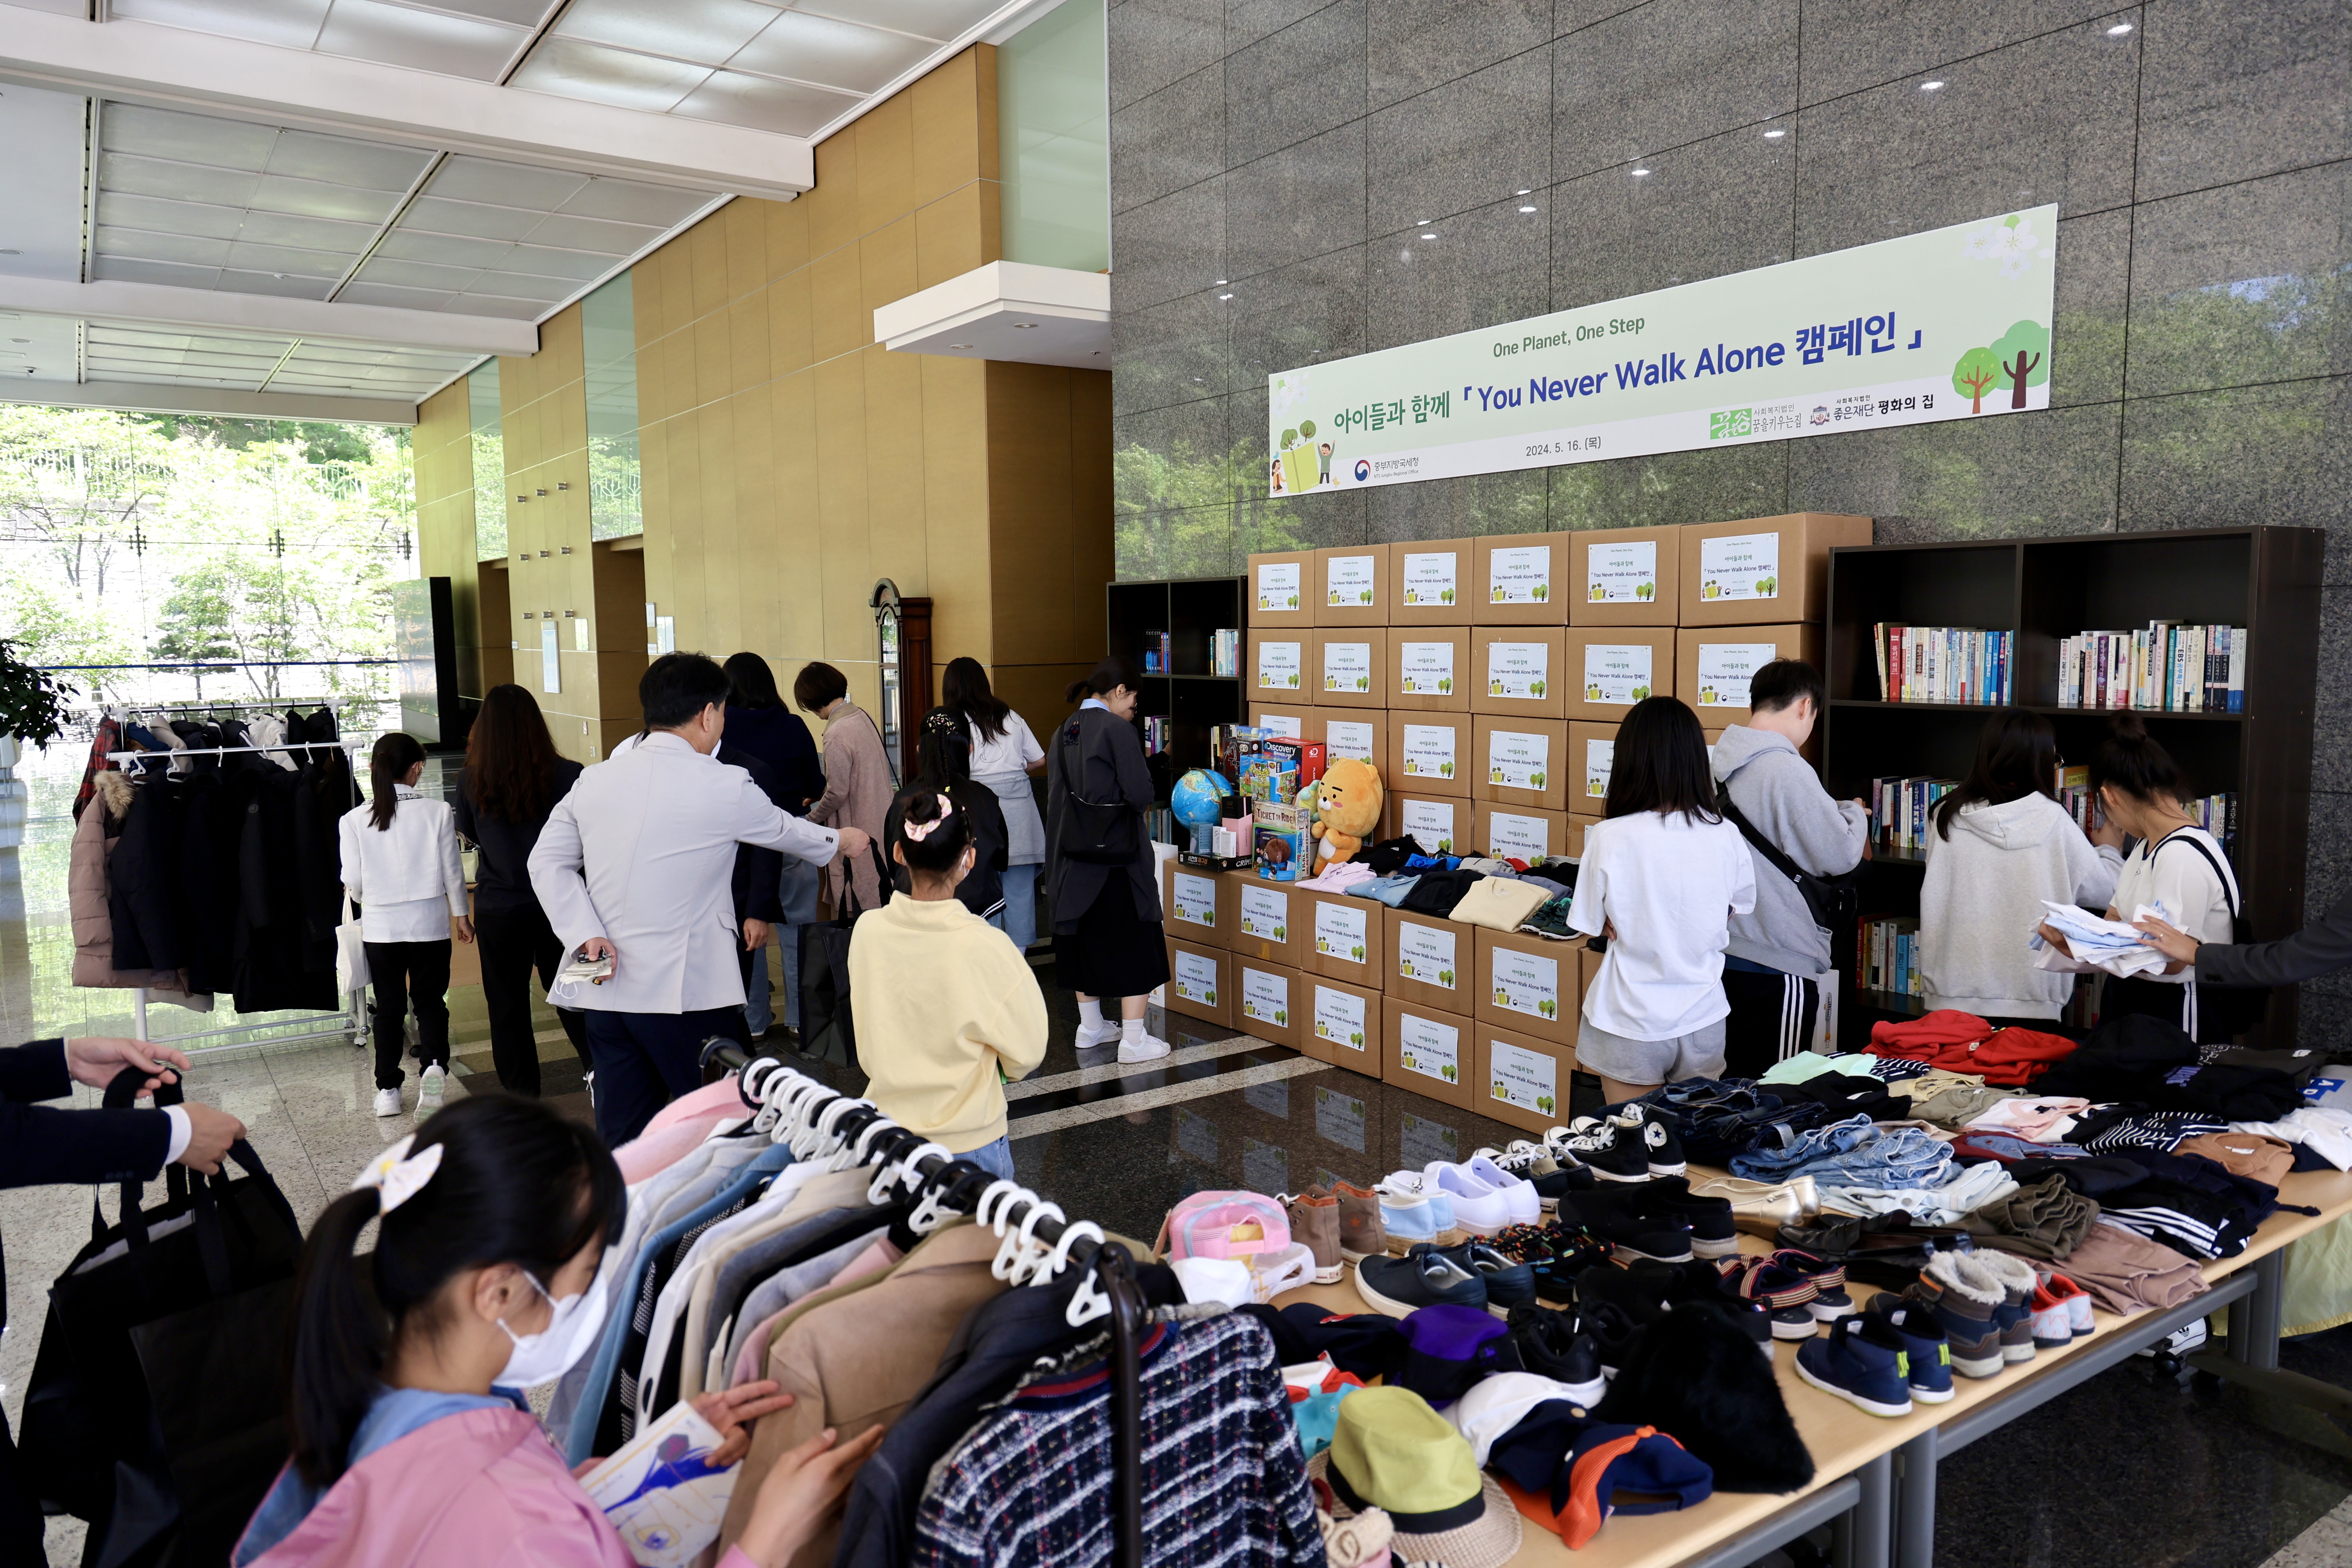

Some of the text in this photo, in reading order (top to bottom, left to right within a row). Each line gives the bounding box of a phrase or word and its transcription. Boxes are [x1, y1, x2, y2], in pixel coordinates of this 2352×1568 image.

[1494, 317, 1645, 358] One Planet, One Step
[1334, 399, 1406, 434] 아이들과
[1411, 390, 1450, 424] 함께
[1530, 372, 1608, 404] Never
[1615, 352, 1686, 390] Walk
[1694, 342, 1785, 378] Alone
[1836, 394, 1870, 404] 사회복지법인
[1754, 403, 1795, 416] 사회복지법인
[1833, 394, 1933, 421] 좋은재단 평화의 집
[1753, 413, 1801, 433] 꿈을키우는집
[1526, 436, 1601, 457] 2024. 5. 16. (목)
[1374, 457, 1419, 471] 중부지방국세청
[1891, 662, 1898, 672] 워크
[1256, 808, 1275, 820] TICKET
[1281, 811, 1293, 824] RIDE
[1236, 858, 1252, 867] CRIME
[1512, 969, 1526, 977] 아이들과
[1510, 1063, 1525, 1073] 아이들과
